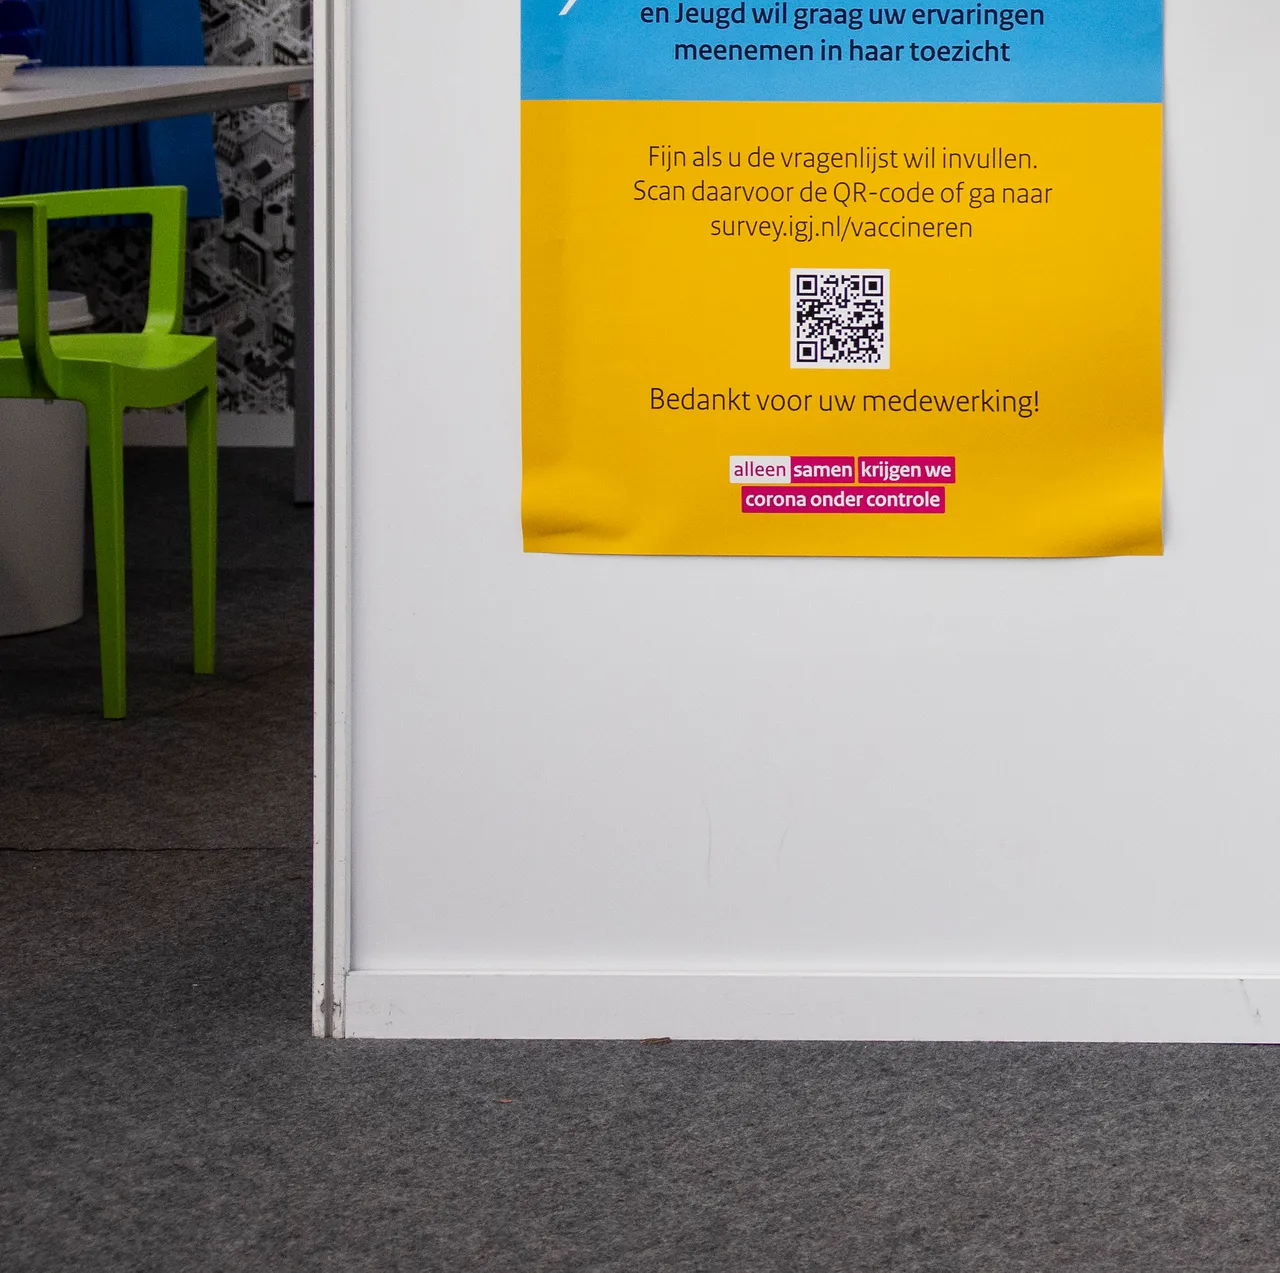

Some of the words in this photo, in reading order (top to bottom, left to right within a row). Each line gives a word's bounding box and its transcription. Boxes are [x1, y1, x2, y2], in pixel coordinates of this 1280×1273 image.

[641, 7, 668, 23] en
[675, 2, 745, 29] Jeugd
[752, 2, 786, 23] wil
[794, 8, 863, 30] graag
[870, 9, 906, 24] uw
[912, 3, 1043, 30] ervaringen
[675, 44, 813, 60] meenemen
[821, 39, 841, 60] in
[850, 39, 904, 61] haar
[910, 40, 1010, 61] toezicht
[650, 145, 685, 171] Fijn
[693, 146, 722, 167] als
[729, 152, 740, 167] u
[748, 146, 774, 167] de
[781, 147, 898, 173] vragenlijst
[904, 147, 934, 168] wil
[943, 147, 1037, 168] invullen.
[634, 180, 684, 200] Scan
[692, 180, 794, 202] daarvoor
[800, 181, 827, 202] de
[834, 182, 934, 207] QR-code
[941, 182, 964, 203] of
[969, 188, 994, 208] ga
[1003, 188, 1052, 203] naar
[711, 215, 971, 242] survey.igj.nl/vaccineren
[651, 387, 750, 410] Bedankt
[757, 395, 812, 411] voor
[820, 395, 855, 411] uw
[864, 389, 1038, 418] medewerking!
[734, 461, 785, 476] alleen
[794, 465, 852, 477] samen
[862, 461, 921, 481] krijgen
[925, 466, 951, 477] we
[746, 495, 806, 506] corona
[811, 491, 863, 506] onder
[867, 491, 940, 507] controle
